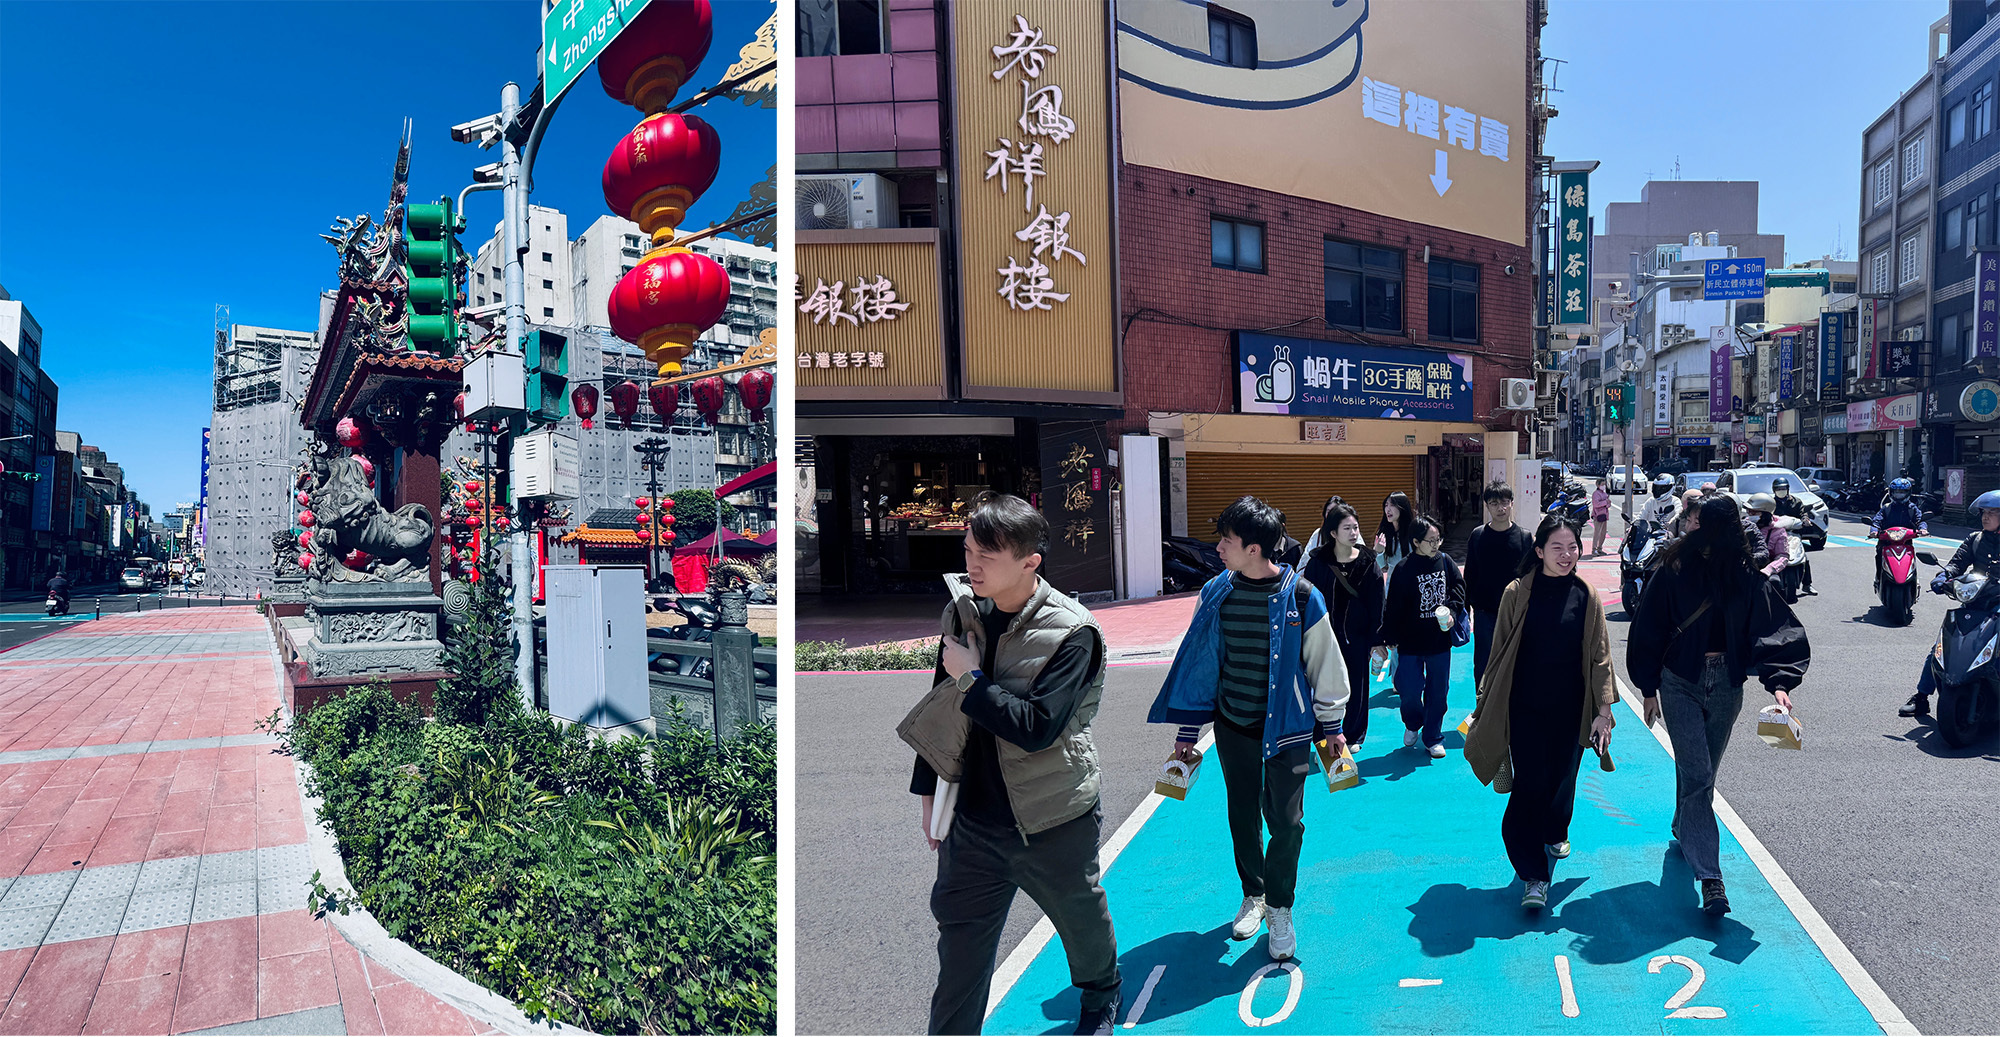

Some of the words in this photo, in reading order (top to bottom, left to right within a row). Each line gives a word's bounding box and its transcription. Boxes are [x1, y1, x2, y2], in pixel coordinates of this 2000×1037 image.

[1362, 76, 1510, 162] 這裡有賣
[984, 13, 1087, 311] 老鳳祥銀樓
[1564, 184, 1586, 312] 綠島茶莊
[1743, 263, 1762, 273] 150m
[1706, 278, 1763, 289] 新民立體停車場
[797, 351, 885, 368] 台灣老字號
[1303, 355, 1357, 390] 蝸牛
[1364, 367, 1422, 391] 3C手機
[1426, 362, 1452, 380] 保貼
[1426, 382, 1452, 400] 配件
[1606, 388, 1621, 400] 44
[1301, 392, 1328, 403] Snail
[1369, 396, 1399, 407] Phone
[1402, 398, 1455, 410] Accessories
[1306, 424, 1347, 441] 旺吉屋
[1061, 442, 1095, 554] 老鳳祥
